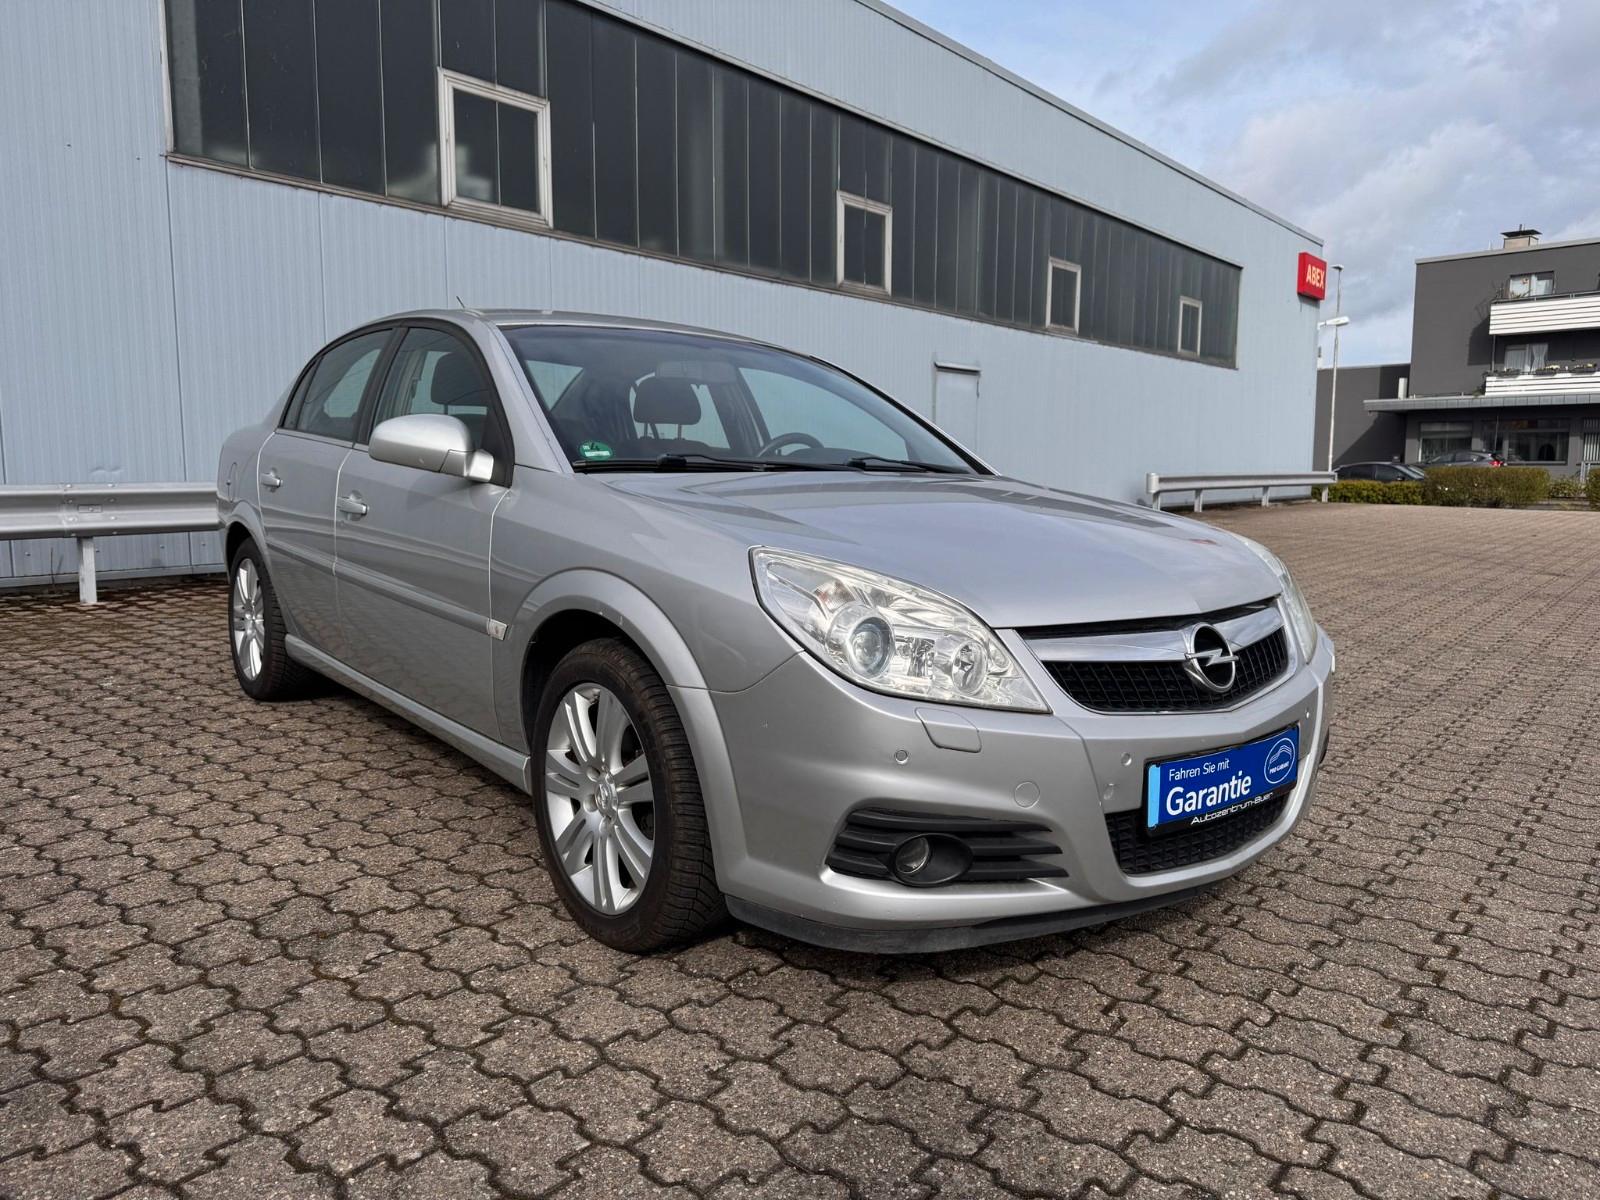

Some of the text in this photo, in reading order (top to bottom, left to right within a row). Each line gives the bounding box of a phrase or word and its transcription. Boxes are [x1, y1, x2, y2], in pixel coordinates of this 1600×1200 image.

[1306, 264, 1325, 289] ABEX
[1169, 758, 1230, 782] Fahren Sie mit
[1166, 770, 1252, 816] Garantie
